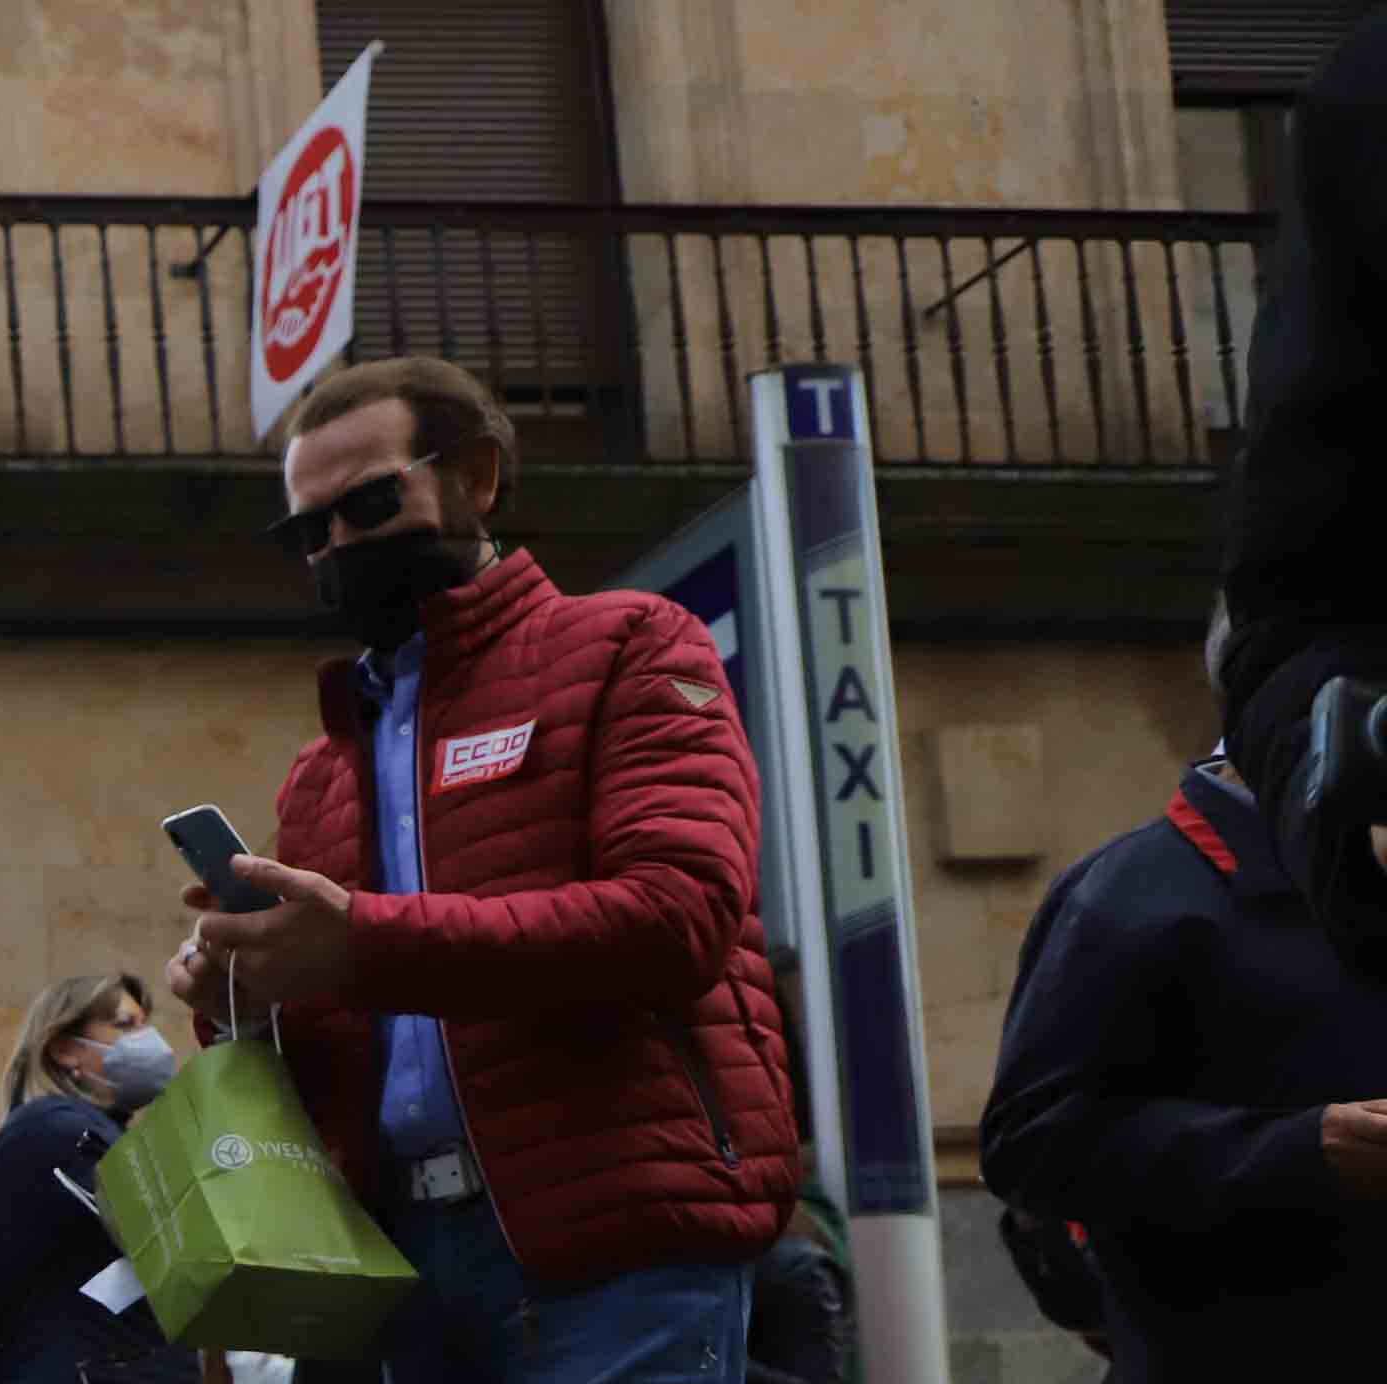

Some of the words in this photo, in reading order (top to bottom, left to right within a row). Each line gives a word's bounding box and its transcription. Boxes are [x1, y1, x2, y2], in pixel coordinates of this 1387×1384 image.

[270, 145, 347, 300] UGT
[798, 379, 843, 434] T
[452, 731, 528, 766] CCOO
[819, 588, 885, 879] TAXI
